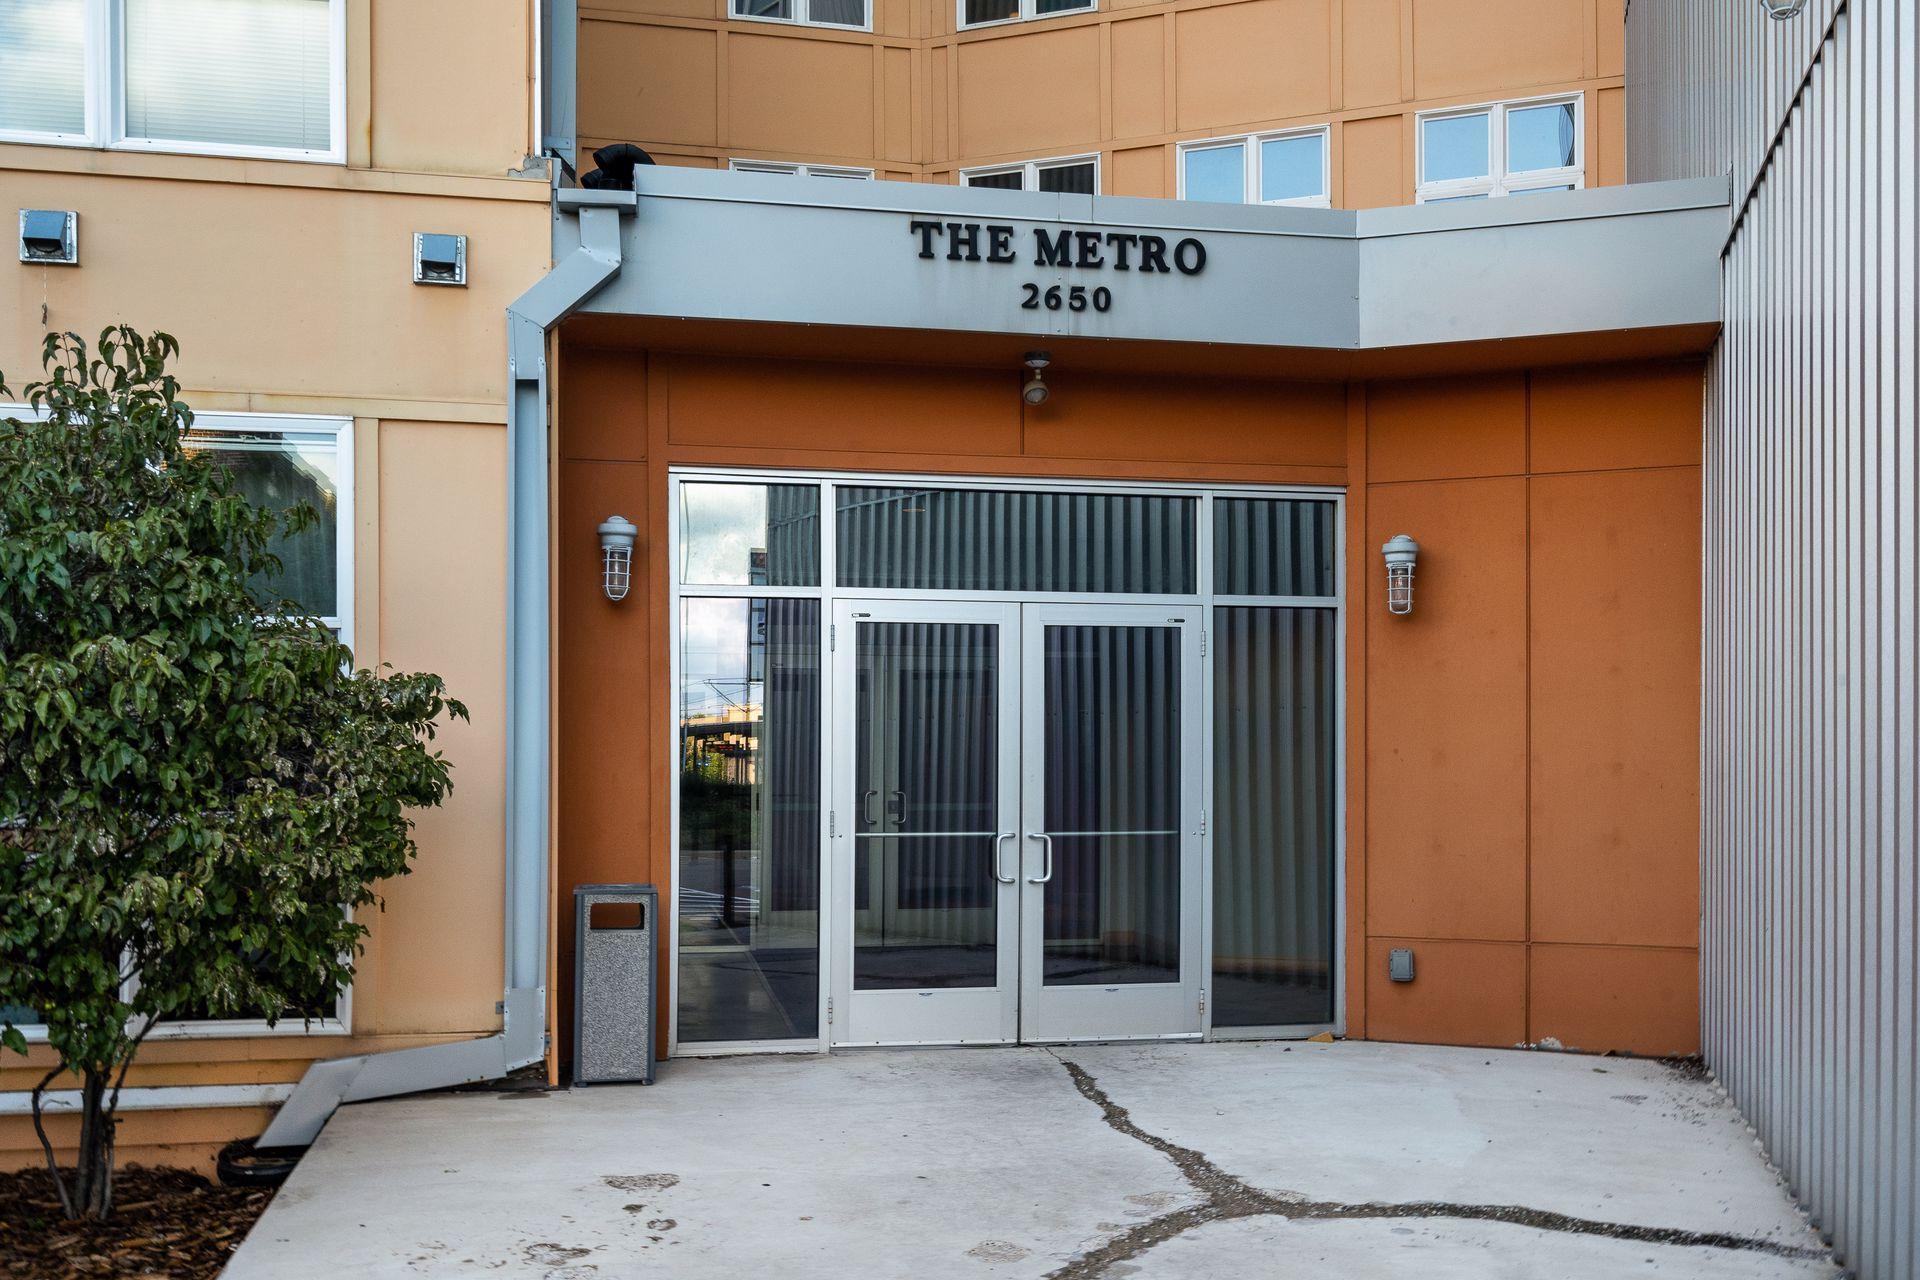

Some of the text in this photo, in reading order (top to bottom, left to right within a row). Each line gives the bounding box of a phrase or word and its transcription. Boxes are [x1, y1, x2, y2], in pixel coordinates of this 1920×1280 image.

[910, 221, 1207, 275] THE METRO
[1021, 283, 1112, 313] 2650
